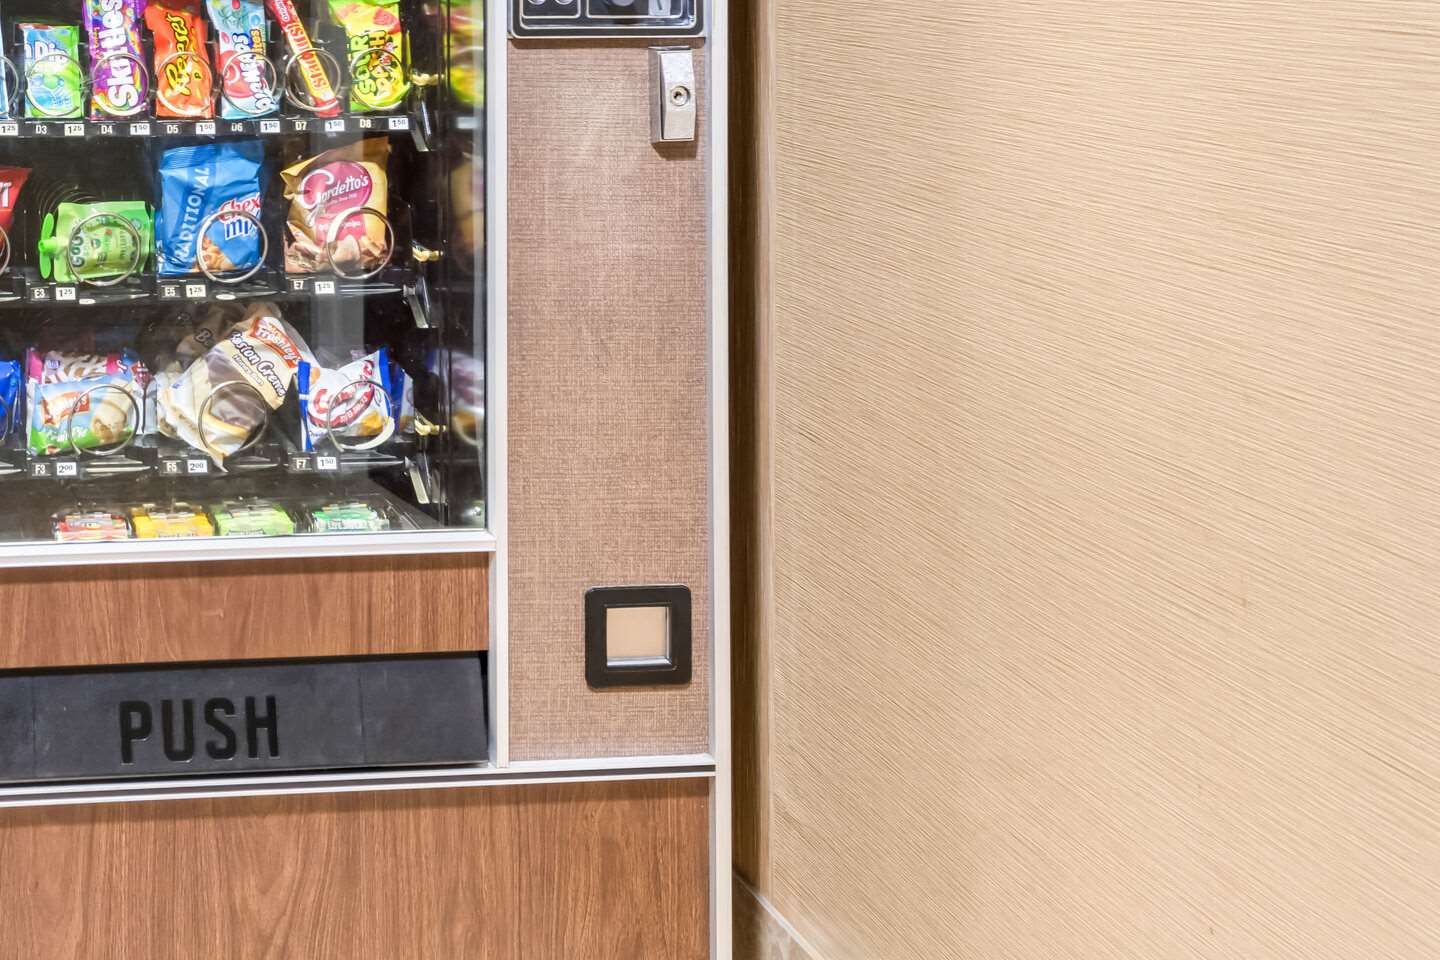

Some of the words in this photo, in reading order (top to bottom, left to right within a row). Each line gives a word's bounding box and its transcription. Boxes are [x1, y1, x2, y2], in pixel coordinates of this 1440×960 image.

[349, 35, 378, 94] SOUR
[35, 124, 47, 135] D3
[101, 124, 113, 135] D4
[166, 124, 179, 134] D5
[231, 122, 244, 132] D6
[295, 121, 307, 131] D7
[164, 287, 176, 297] E5
[257, 360, 288, 397] Creme
[296, 459, 306, 469] F7
[119, 695, 280, 765] PUSH
